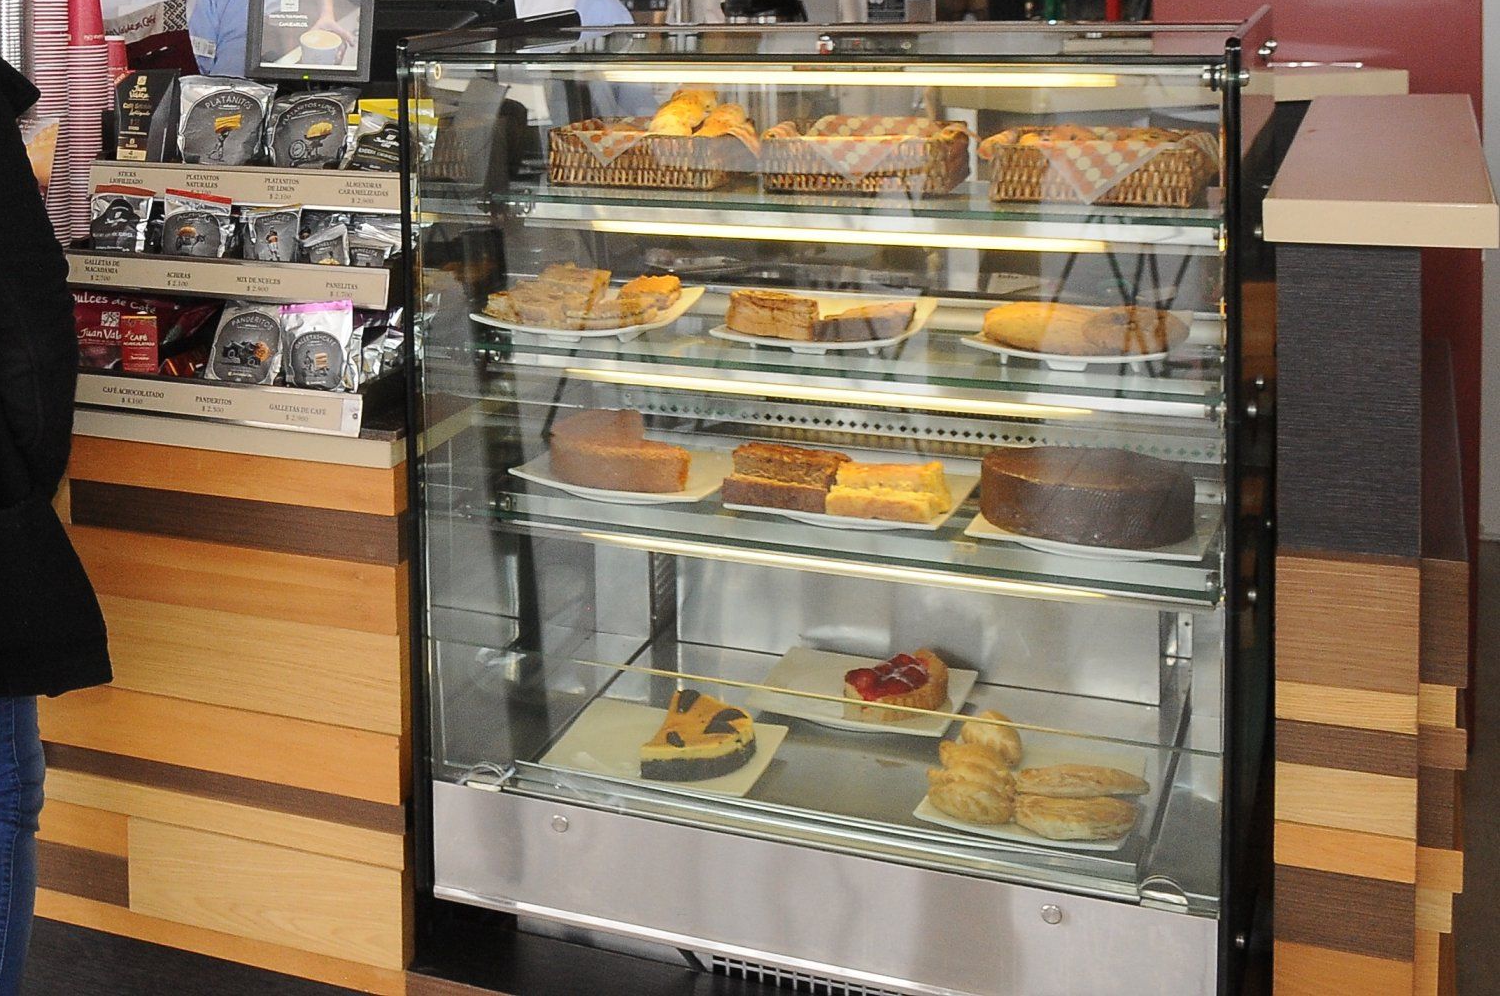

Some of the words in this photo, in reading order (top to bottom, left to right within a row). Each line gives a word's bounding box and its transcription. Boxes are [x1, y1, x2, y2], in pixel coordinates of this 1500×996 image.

[204, 94, 253, 110] PLATANITOS
[186, 174, 220, 182] PLATANITOS
[264, 177, 300, 186] PLATANITOS
[186, 181, 219, 189] NATURALES
[338, 188, 389, 197] CARAMELIZADAS
[84, 258, 111, 267] GALLETAS
[325, 281, 358, 291] PANELITAS
[230, 315, 275, 331] PANDERITOS
[77, 328, 102, 339] Juan
[195, 395, 232, 406] PANDERITOS
[269, 403, 300, 414] GALLETAS
